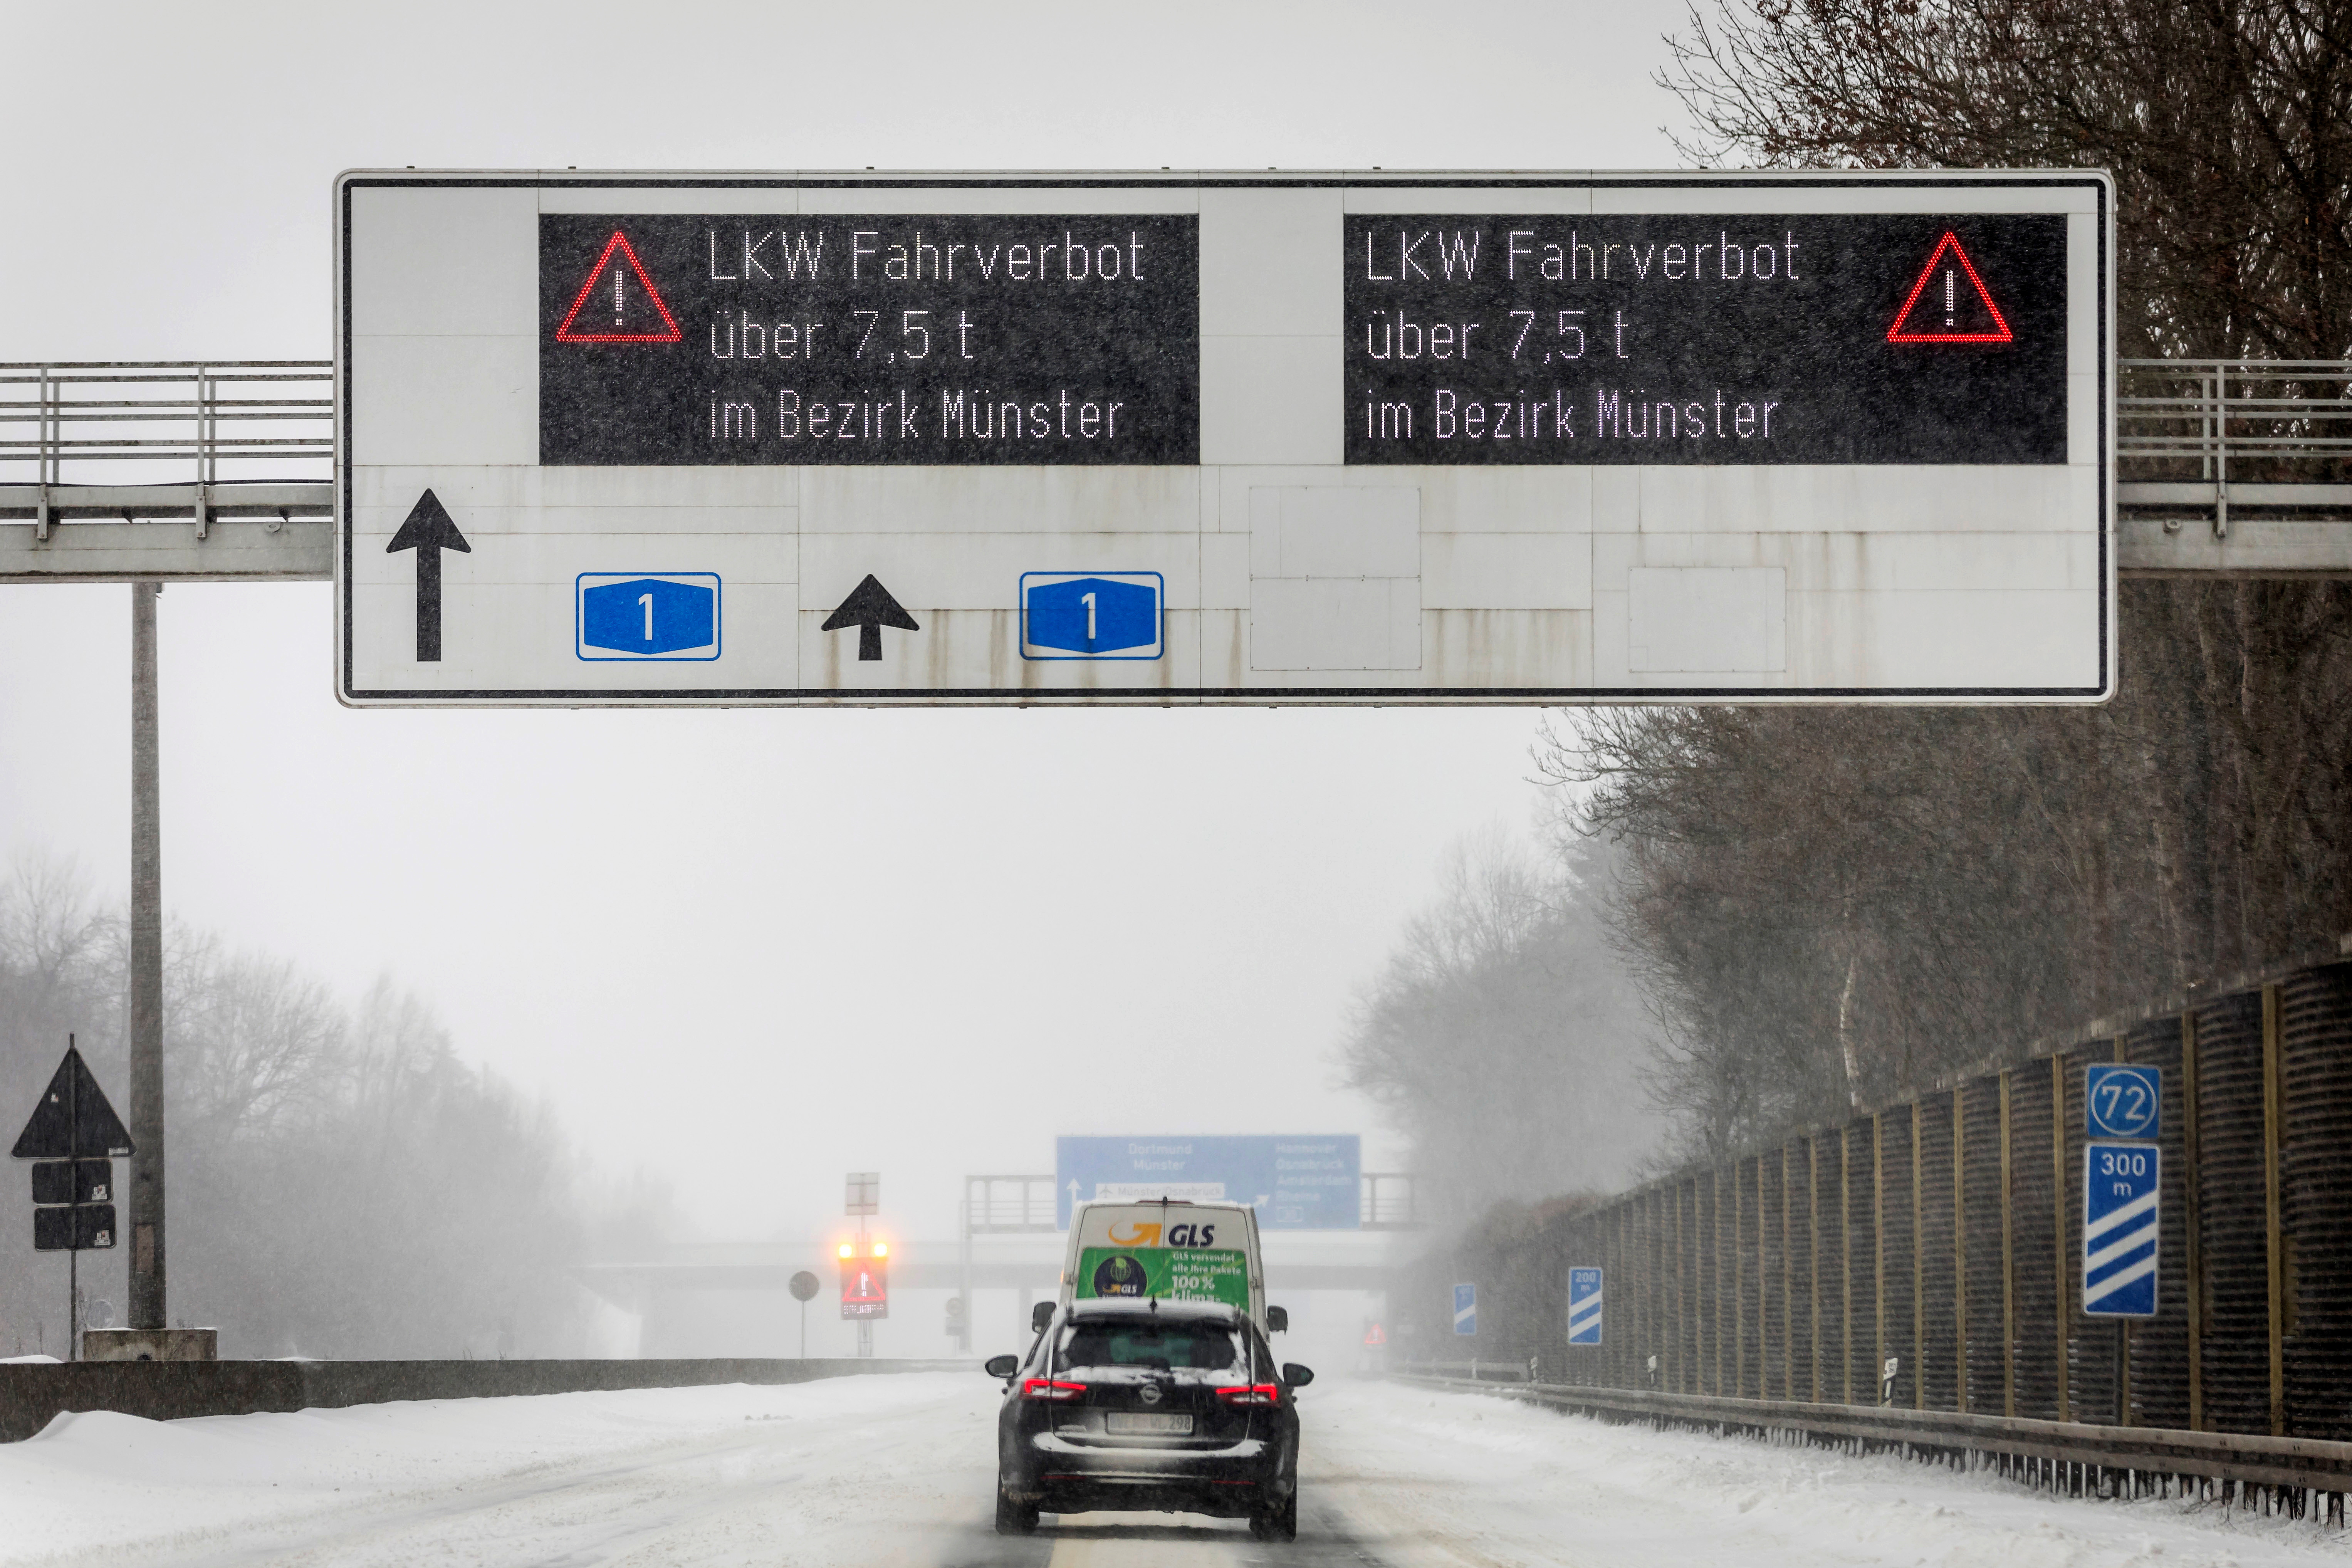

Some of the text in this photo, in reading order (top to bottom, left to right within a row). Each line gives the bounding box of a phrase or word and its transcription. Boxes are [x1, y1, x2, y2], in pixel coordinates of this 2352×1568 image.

[712, 231, 1143, 280] LKW Fahrverbot
[1368, 231, 1799, 280] LKW Fahrverbot
[712, 311, 973, 364] über 7,5 t
[1368, 310, 1628, 364] über 7,5 t
[712, 389, 1123, 438] im Bezirk Münster
[1368, 389, 1778, 438] im Bezirk Münster
[638, 593, 653, 640] 1
[1081, 593, 1096, 639] 1
[2102, 1085, 2146, 1120] 72
[1128, 1143, 1192, 1155] Dortmund
[1134, 1159, 1185, 1170] Münster
[2101, 1153, 2146, 1176] 300
[2113, 1182, 2132, 1196] m
[1168, 1223, 1215, 1247] GLS
[1172, 1262, 1241, 1275] alle Ihre Pakete
[1173, 1251, 1235, 1262] GLS versendet
[1121, 1284, 1137, 1294] GLS
[1172, 1275, 1215, 1290] 100 %
[1575, 1272, 1596, 1283] 200
